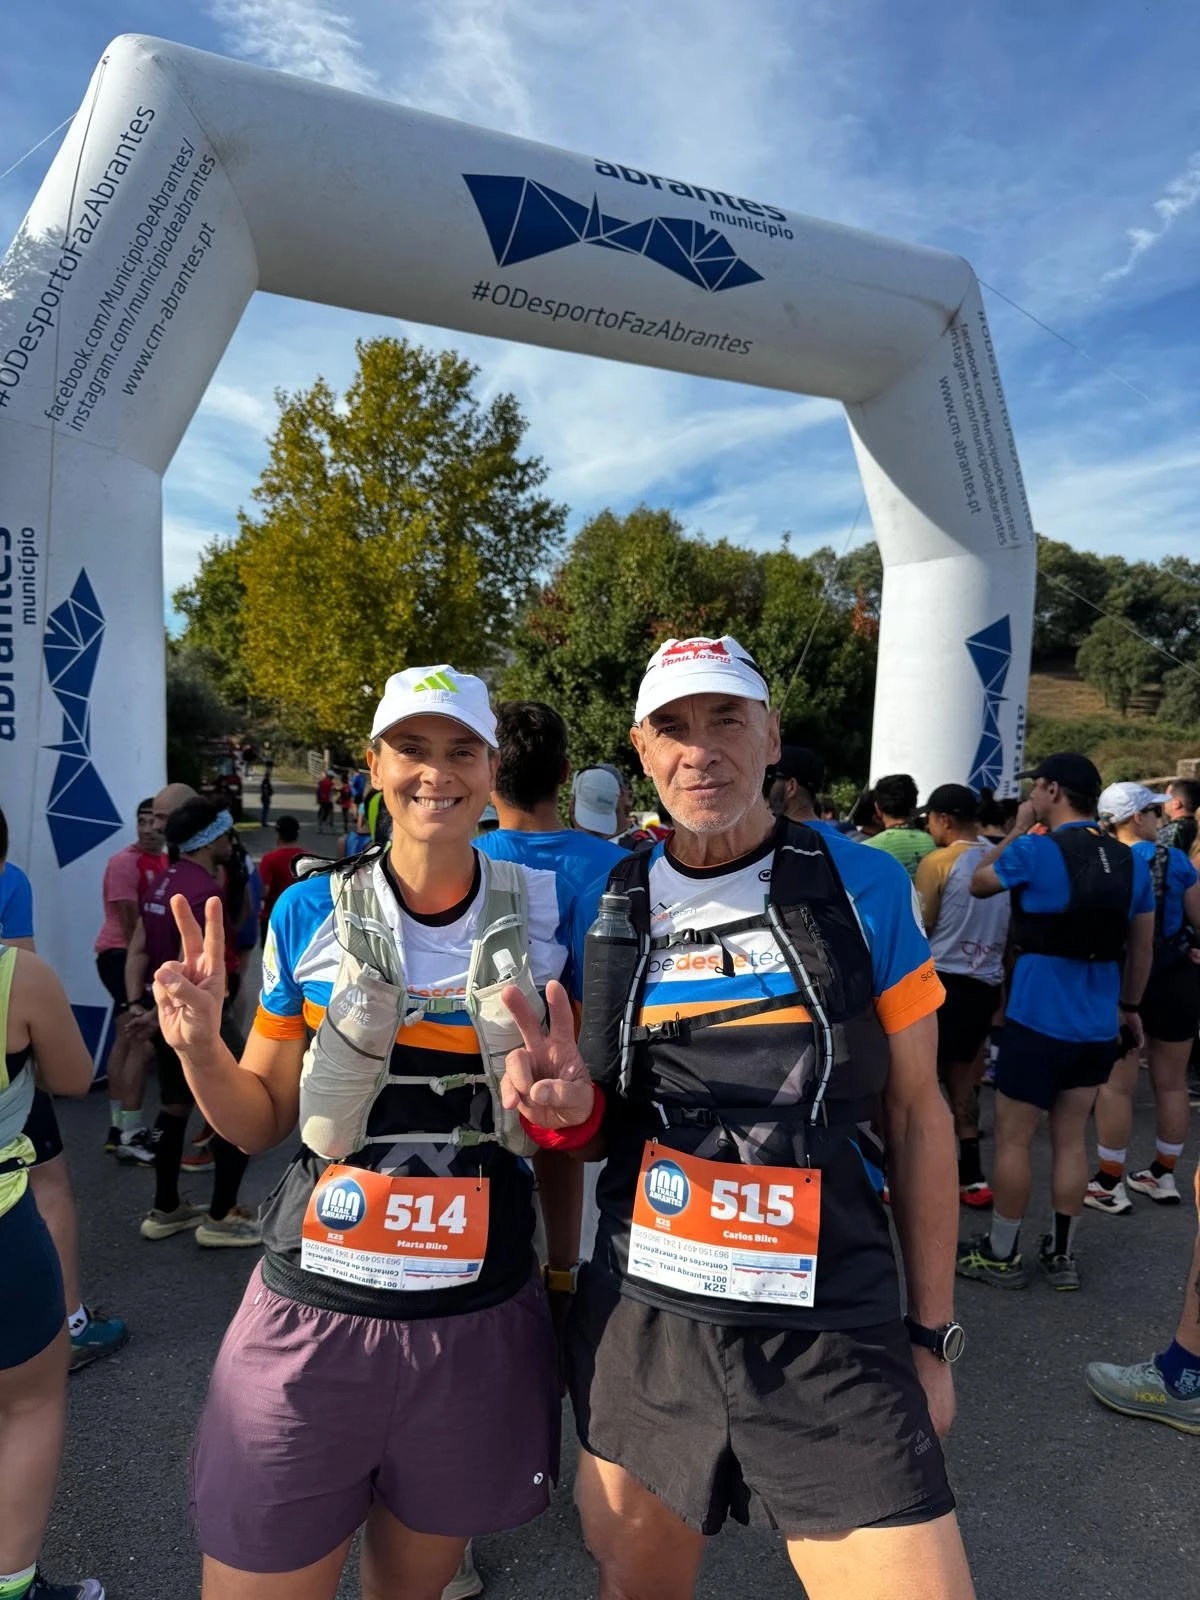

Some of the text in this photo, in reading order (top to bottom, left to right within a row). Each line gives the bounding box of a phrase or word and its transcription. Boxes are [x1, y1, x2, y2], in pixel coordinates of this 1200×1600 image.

[594, 158, 788, 222] abrantes
[710, 208, 794, 241] município
[44, 136, 197, 422] facebook.com/MunicipioDeAbrantes/
[66, 153, 217, 433] instagram.com/municipiodeabrantes
[122, 221, 217, 397] www.cm-abrantes.pt
[471, 279, 754, 356] #ODesportoFazAbrantes
[938, 375, 982, 515] www.cm-abrantes.pt
[18, 526, 39, 625] município
[650, 1168, 685, 1201] 100
[657, 1187, 676, 1198] TRAIL
[322, 1186, 361, 1217] 100
[330, 1205, 350, 1215] TRAIL
[710, 1178, 794, 1227] 515
[320, 1209, 358, 1223] ABRANTES
[384, 1193, 467, 1235] 514
[327, 1232, 344, 1241] K25
[396, 1239, 448, 1251] Marta Bilro
[722, 1230, 779, 1244] Carlos Bilro
[351, 1263, 361, 1271] de
[679, 1255, 689, 1263] de
[689, 1257, 728, 1271] Contactos
[331, 1268, 350, 1279] Trail
[350, 1272, 383, 1287] Abrantes
[361, 1265, 399, 1277] Contactos
[659, 1262, 728, 1284] Trail Abrantes 100
[704, 1281, 727, 1293] K25
[1134, 1391, 1168, 1404] HOKA
